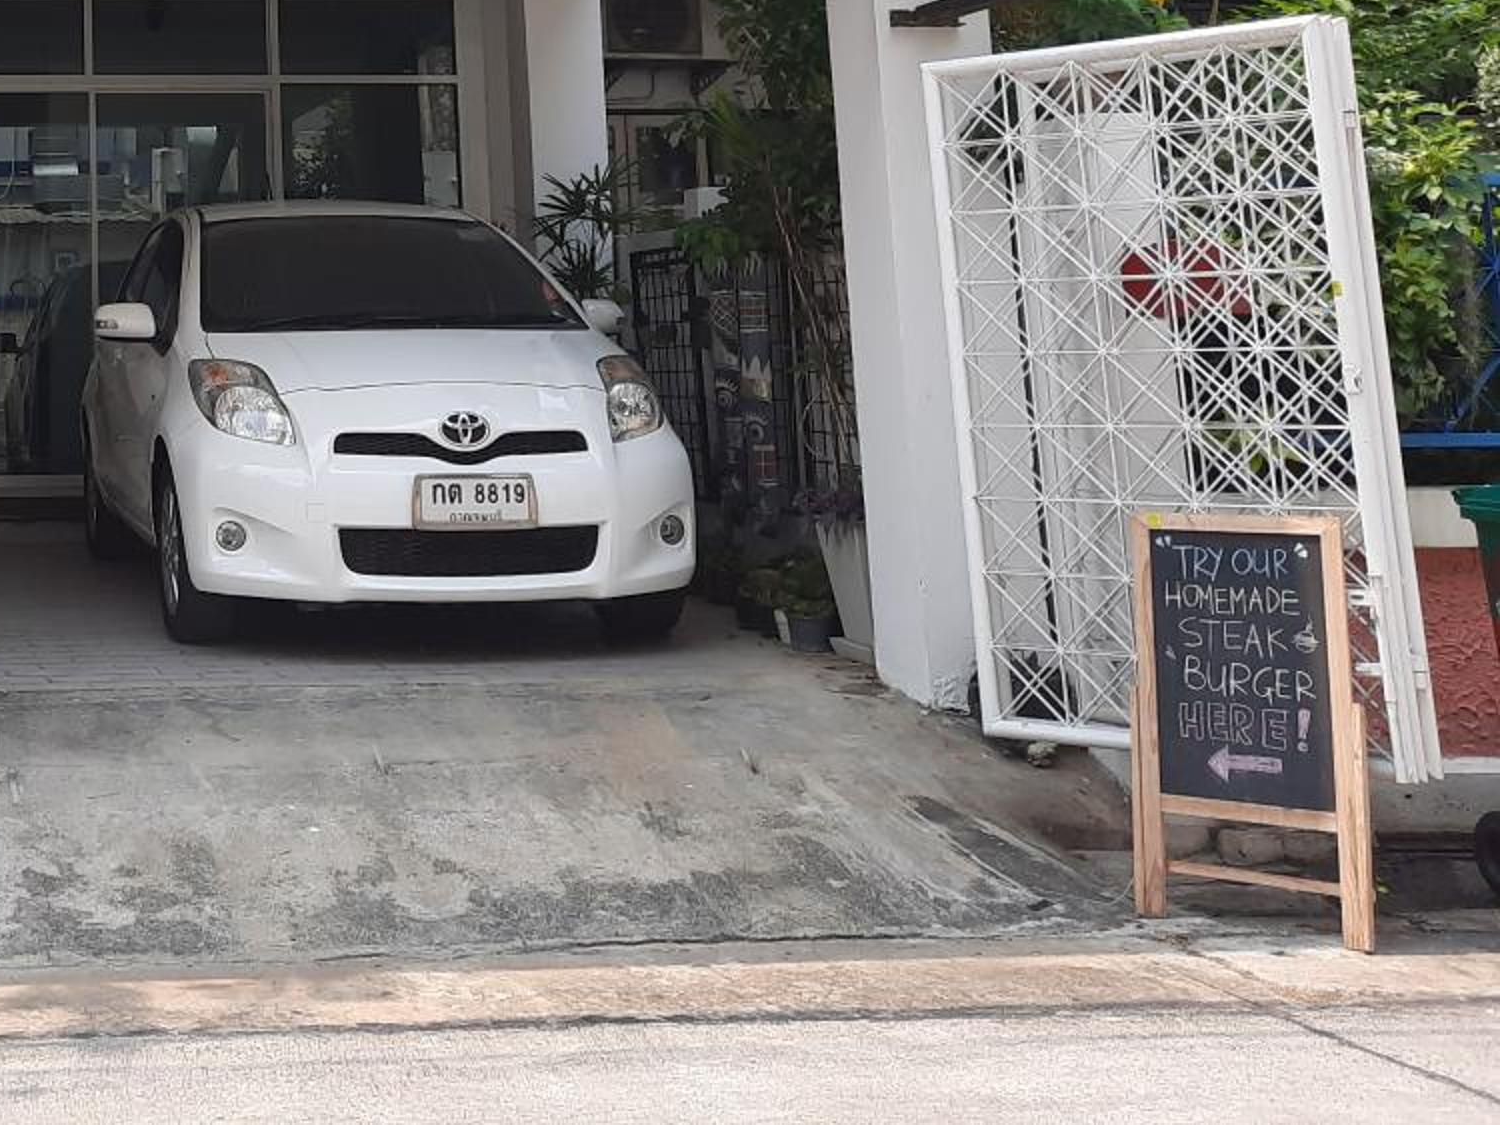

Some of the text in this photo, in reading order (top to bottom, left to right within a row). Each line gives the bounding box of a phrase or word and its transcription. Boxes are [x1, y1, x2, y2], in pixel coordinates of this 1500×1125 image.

[474, 483, 526, 504] 8819
[1164, 581, 1300, 616] HOMEMADE
[1178, 616, 1288, 659] STEAK
[1184, 654, 1317, 705] BURGER
